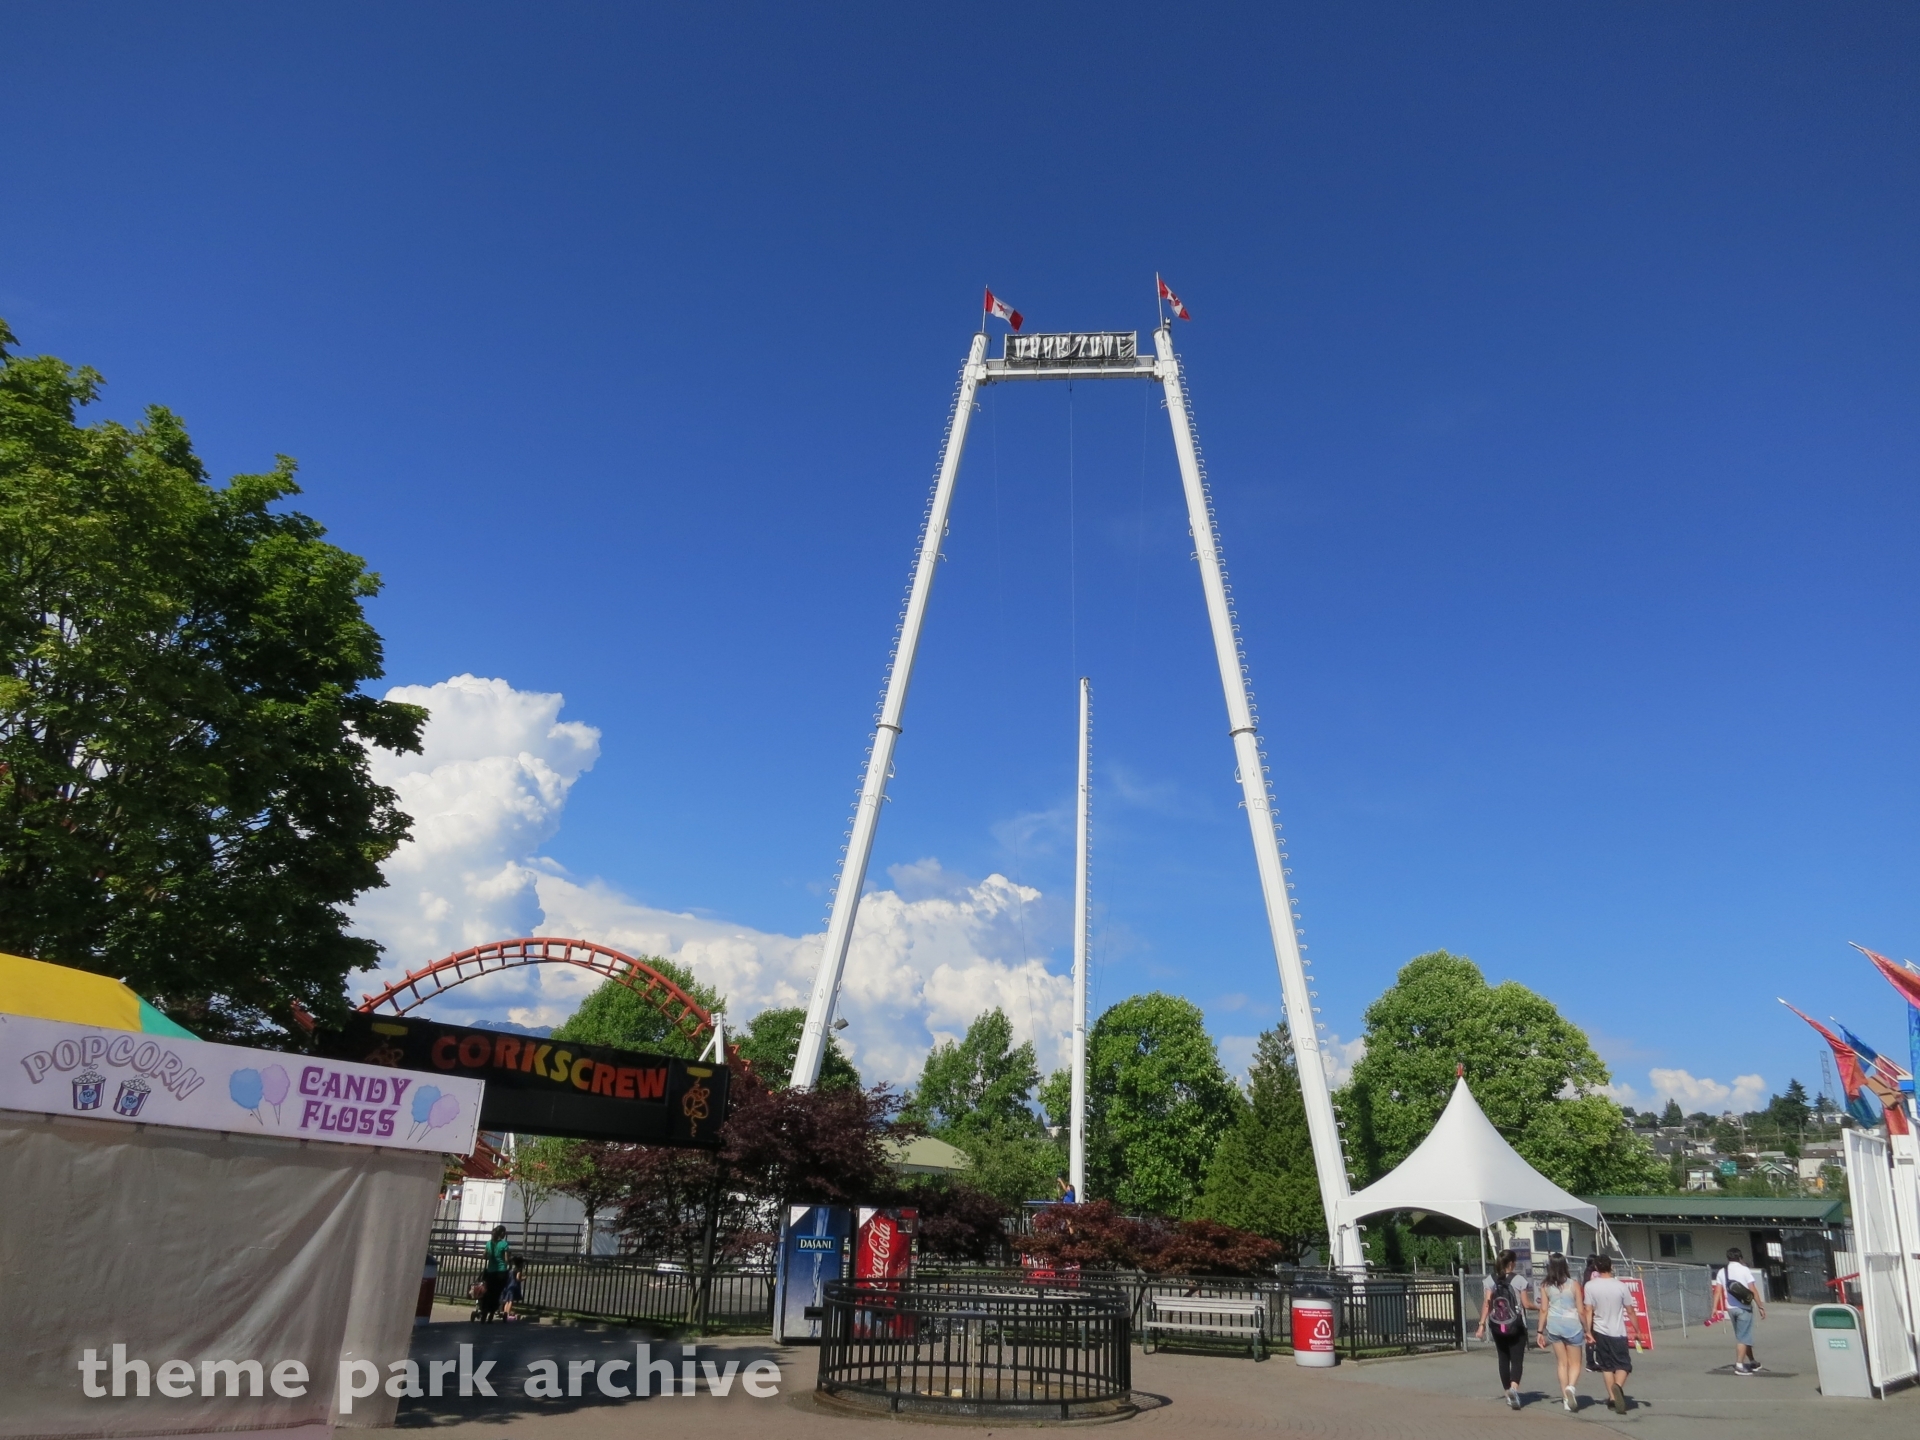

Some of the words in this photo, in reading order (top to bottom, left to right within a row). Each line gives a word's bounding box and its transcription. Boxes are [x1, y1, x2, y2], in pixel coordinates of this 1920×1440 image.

[1014, 336, 1069, 358] DROP
[1073, 334, 1127, 357] ZONE
[21, 1035, 205, 1101] POPCORN
[431, 1034, 667, 1098] CORKSCREW
[299, 1066, 413, 1106] CANDY
[300, 1100, 397, 1137] FLOSS
[800, 1239, 832, 1249] DASANI
